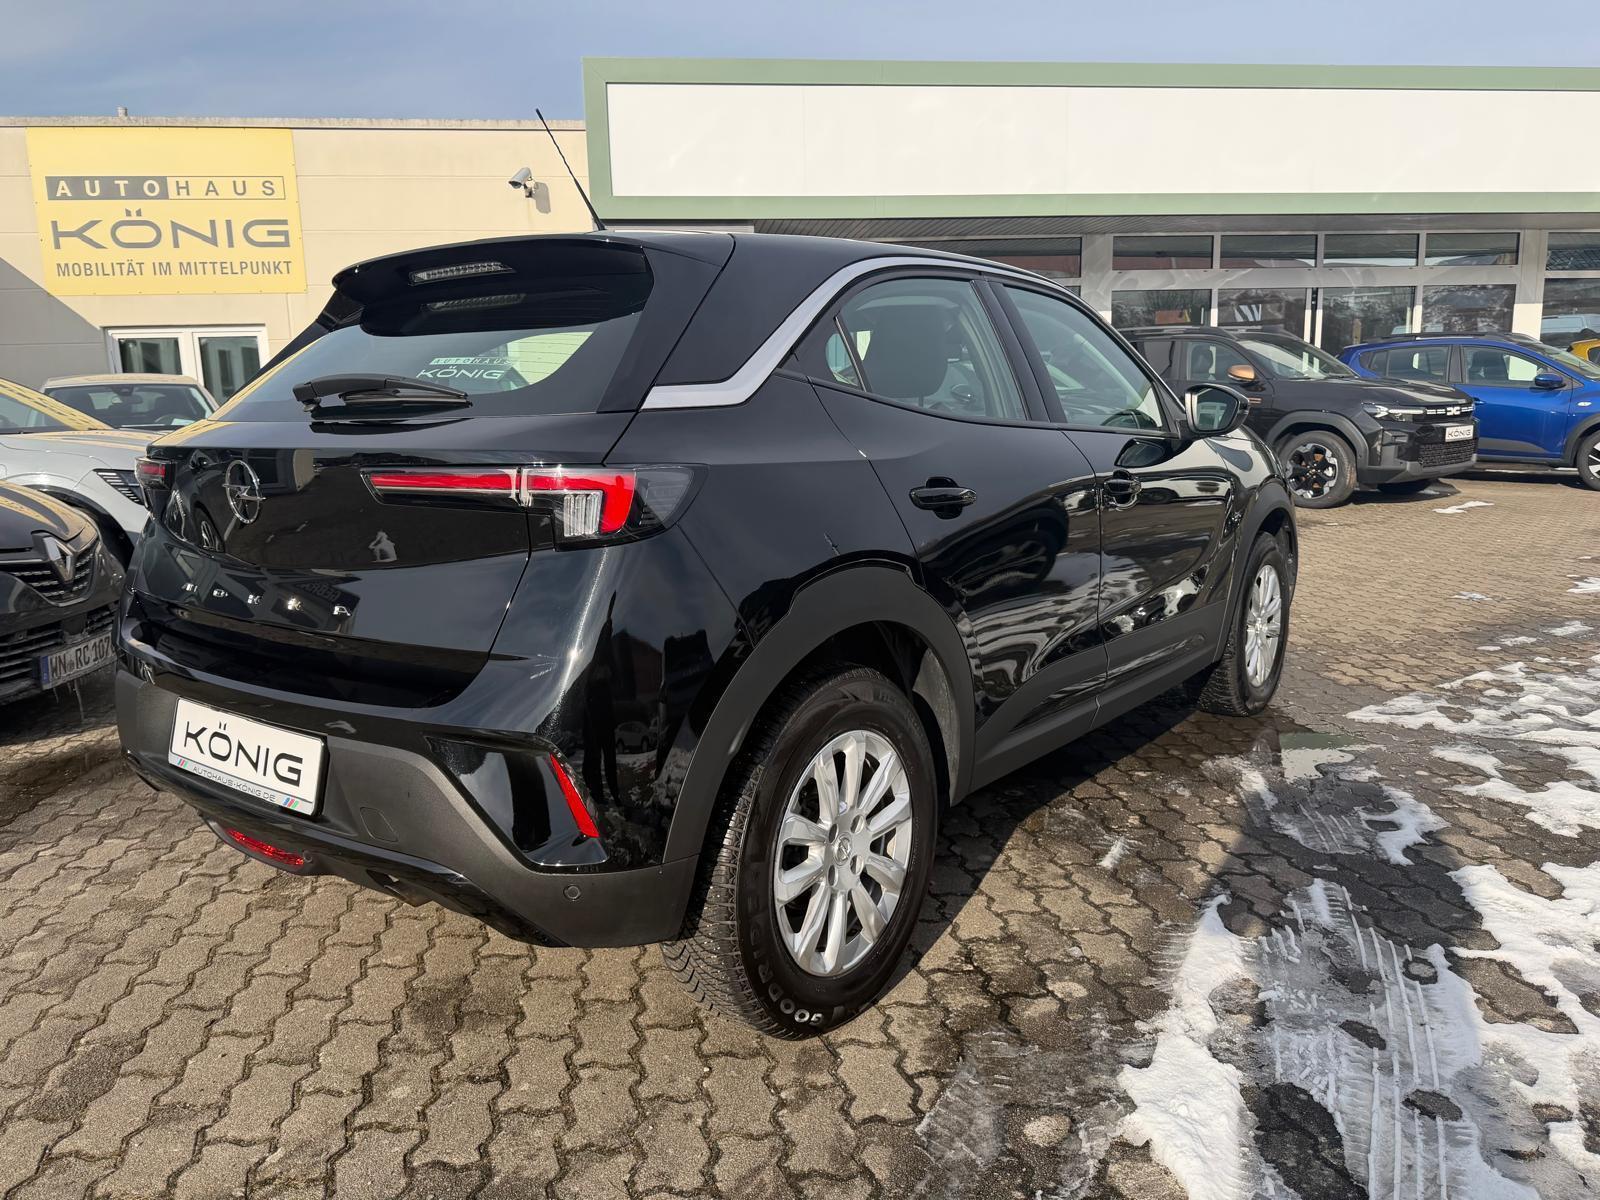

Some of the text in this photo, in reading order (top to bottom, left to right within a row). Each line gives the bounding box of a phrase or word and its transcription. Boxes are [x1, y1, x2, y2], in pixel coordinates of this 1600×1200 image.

[55, 179, 276, 198] AUTOHAUS
[50, 208, 291, 250] KÖNIG
[55, 258, 293, 277] MOBILITÄT IM MITTELPUNKT
[415, 365, 506, 380] KÖNIG
[75, 643, 91, 669] RC
[183, 720, 303, 788] KÖNIG
